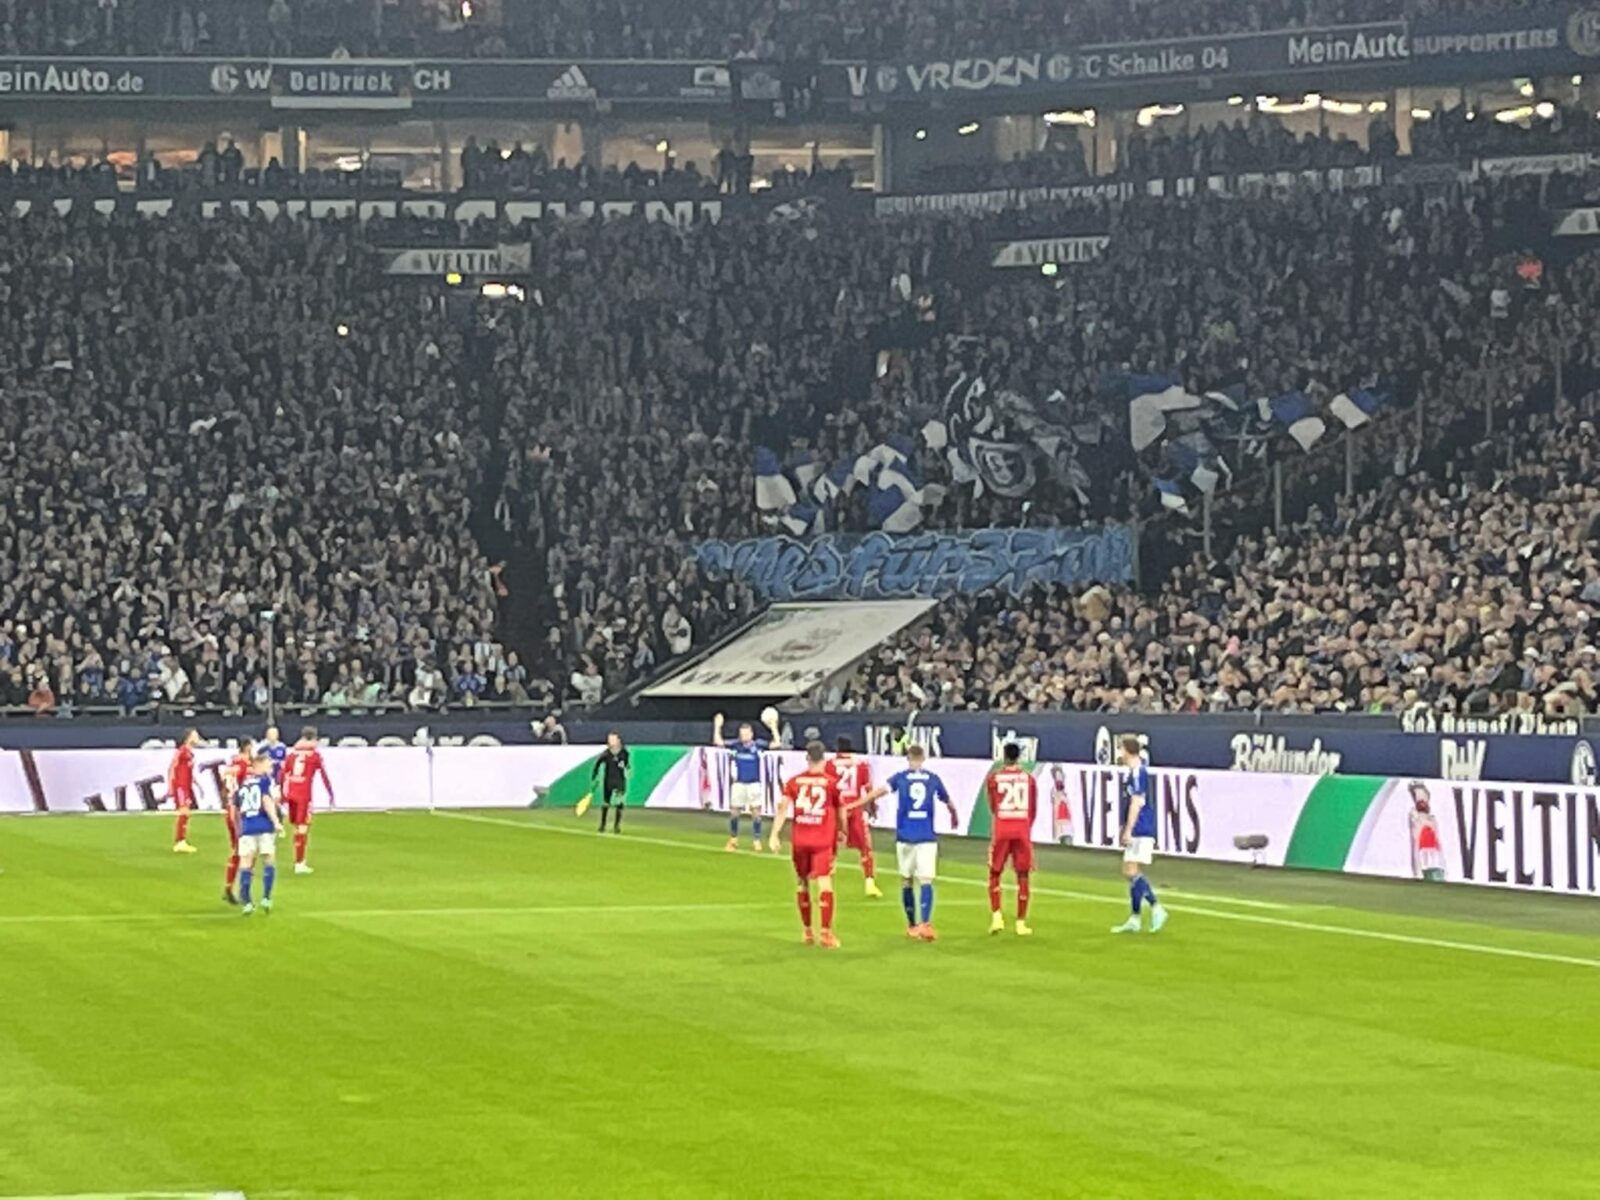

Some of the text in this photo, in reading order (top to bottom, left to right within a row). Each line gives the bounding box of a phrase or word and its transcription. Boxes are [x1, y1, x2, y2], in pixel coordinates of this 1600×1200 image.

[1413, 28, 1558, 54] SUPPORTERS
[906, 54, 1041, 92] VREDEN
[1107, 50, 1195, 76] Schalke
[1202, 46, 1229, 69] 04
[413, 70, 451, 90] CH
[836, 766, 858, 795] 21
[796, 786, 827, 816] 42
[909, 782, 926, 810] 9
[998, 782, 1028, 811] 20
